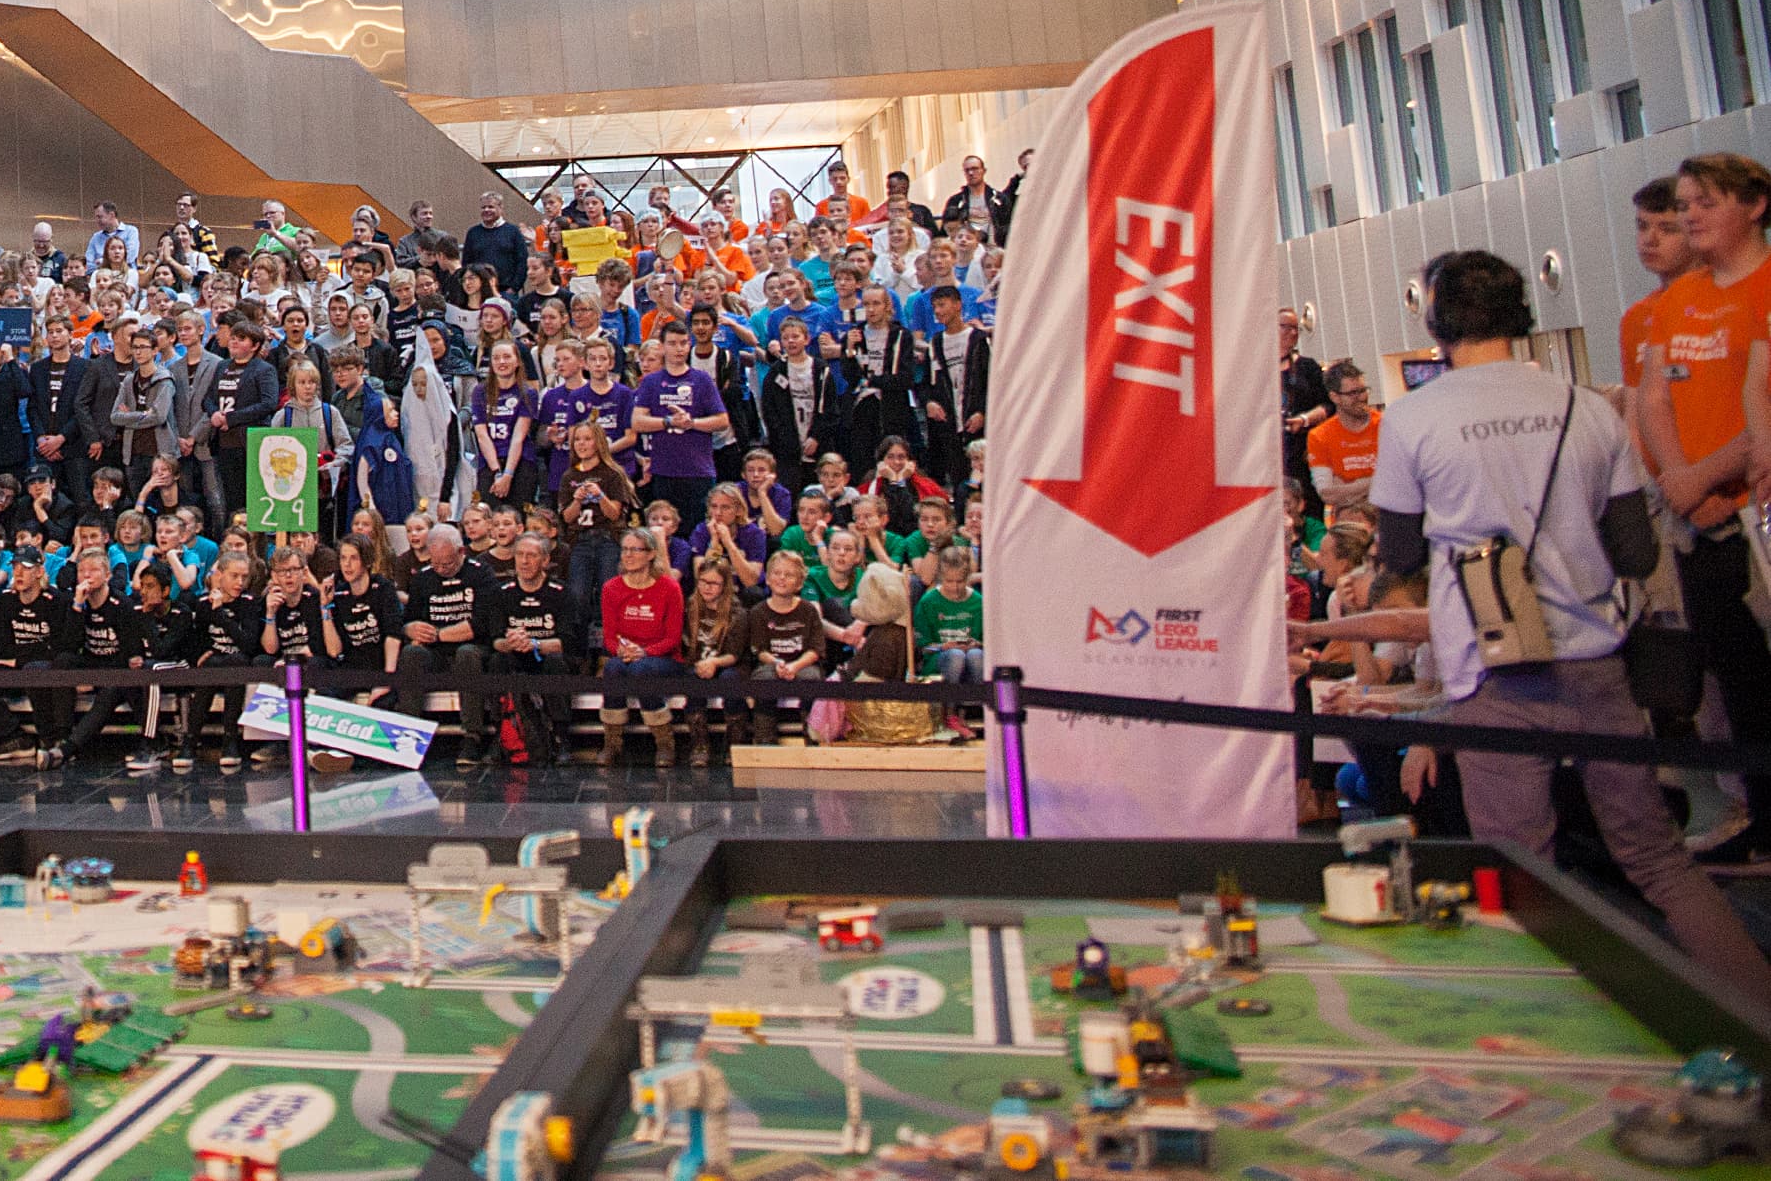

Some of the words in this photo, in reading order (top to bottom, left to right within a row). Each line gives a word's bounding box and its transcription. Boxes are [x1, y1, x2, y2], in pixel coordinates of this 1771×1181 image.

[1113, 196, 1195, 416] EXIT
[488, 423, 508, 440] 13
[1156, 609, 1202, 622] FIRST
[1155, 622, 1199, 637] LEGO
[1156, 637, 1219, 652] LEAGUE
